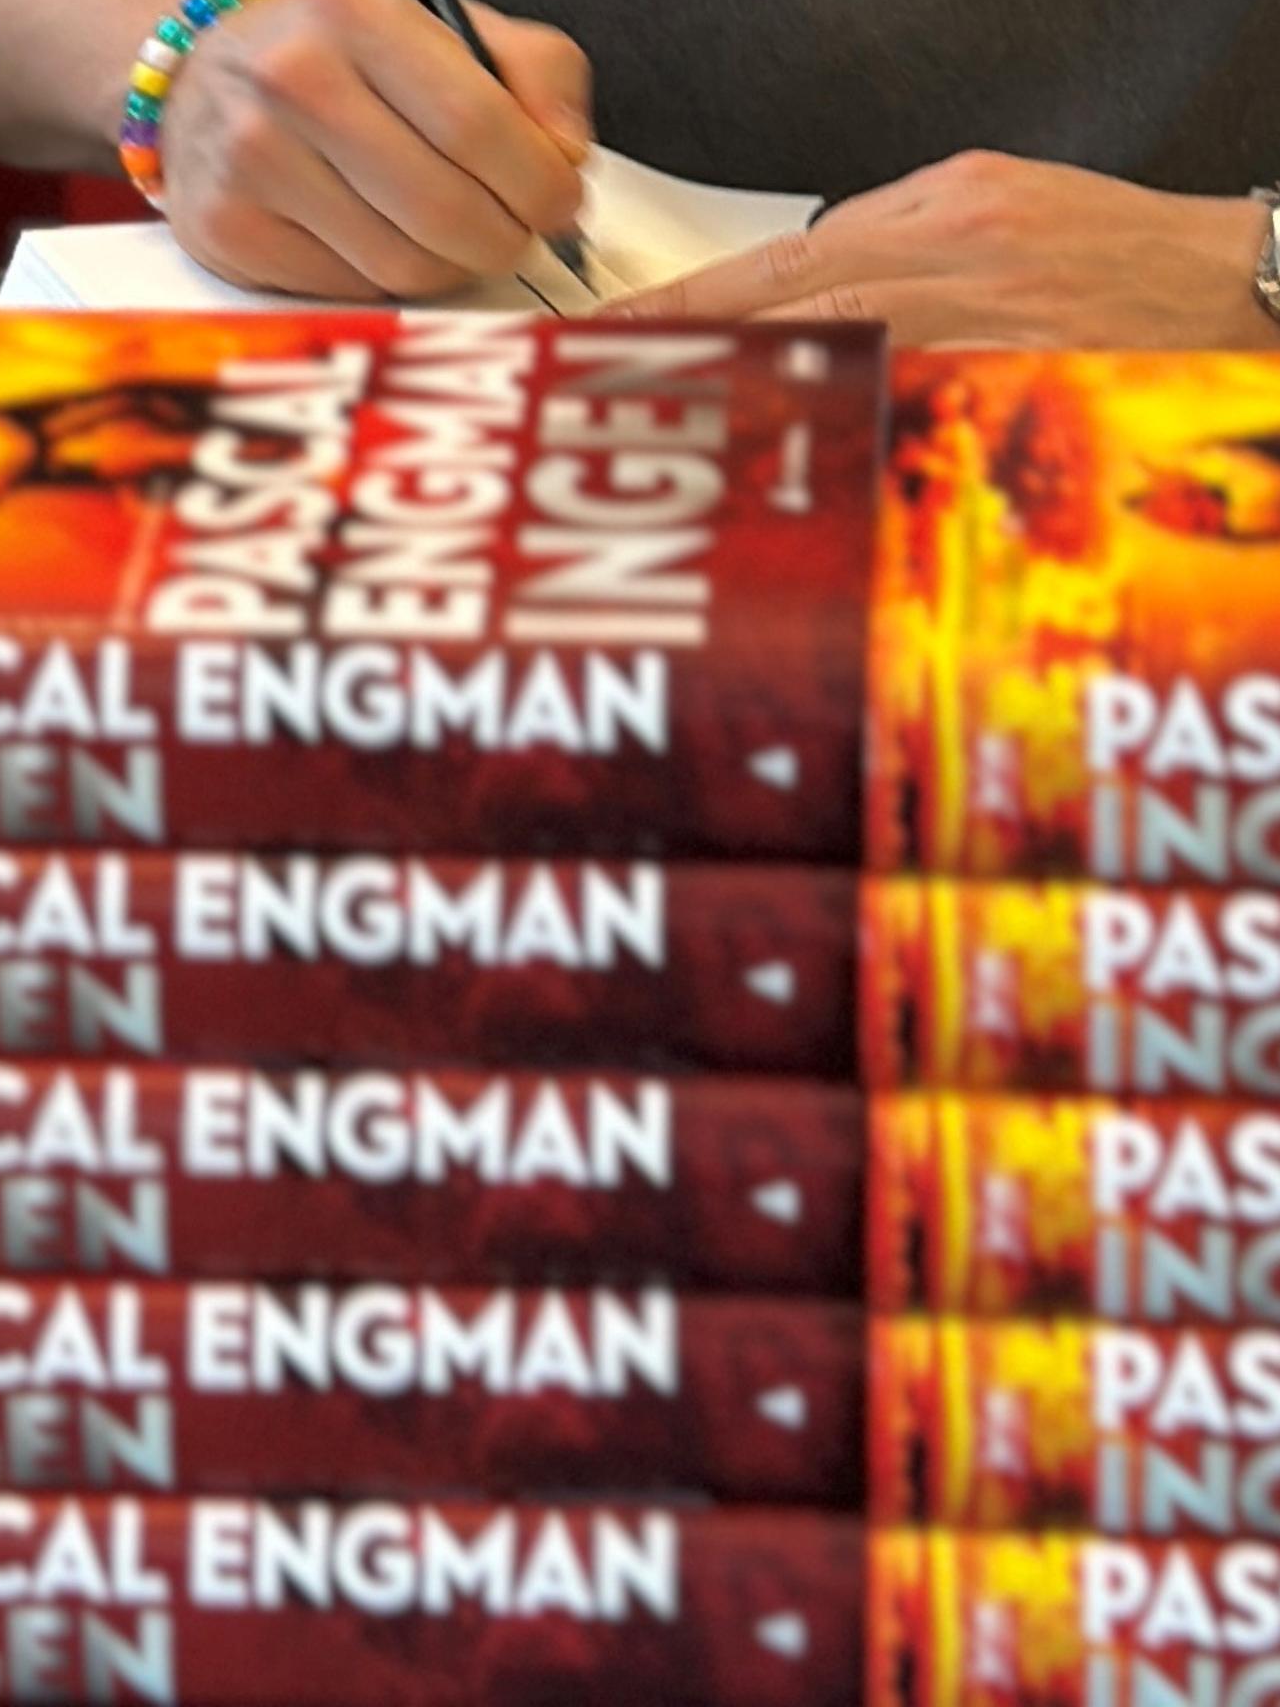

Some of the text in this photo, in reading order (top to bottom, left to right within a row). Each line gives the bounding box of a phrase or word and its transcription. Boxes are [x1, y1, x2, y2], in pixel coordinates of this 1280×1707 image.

[146, 342, 373, 637] PASCAL
[322, 310, 540, 639] ENGMAN
[505, 332, 735, 645] INGEN
[178, 642, 667, 755] ENGMAN
[176, 854, 665, 969] ENGMAN
[182, 1069, 671, 1187] ENGMAN
[189, 1282, 678, 1399] ENGMAN
[189, 1499, 678, 1618] ENGMAN
